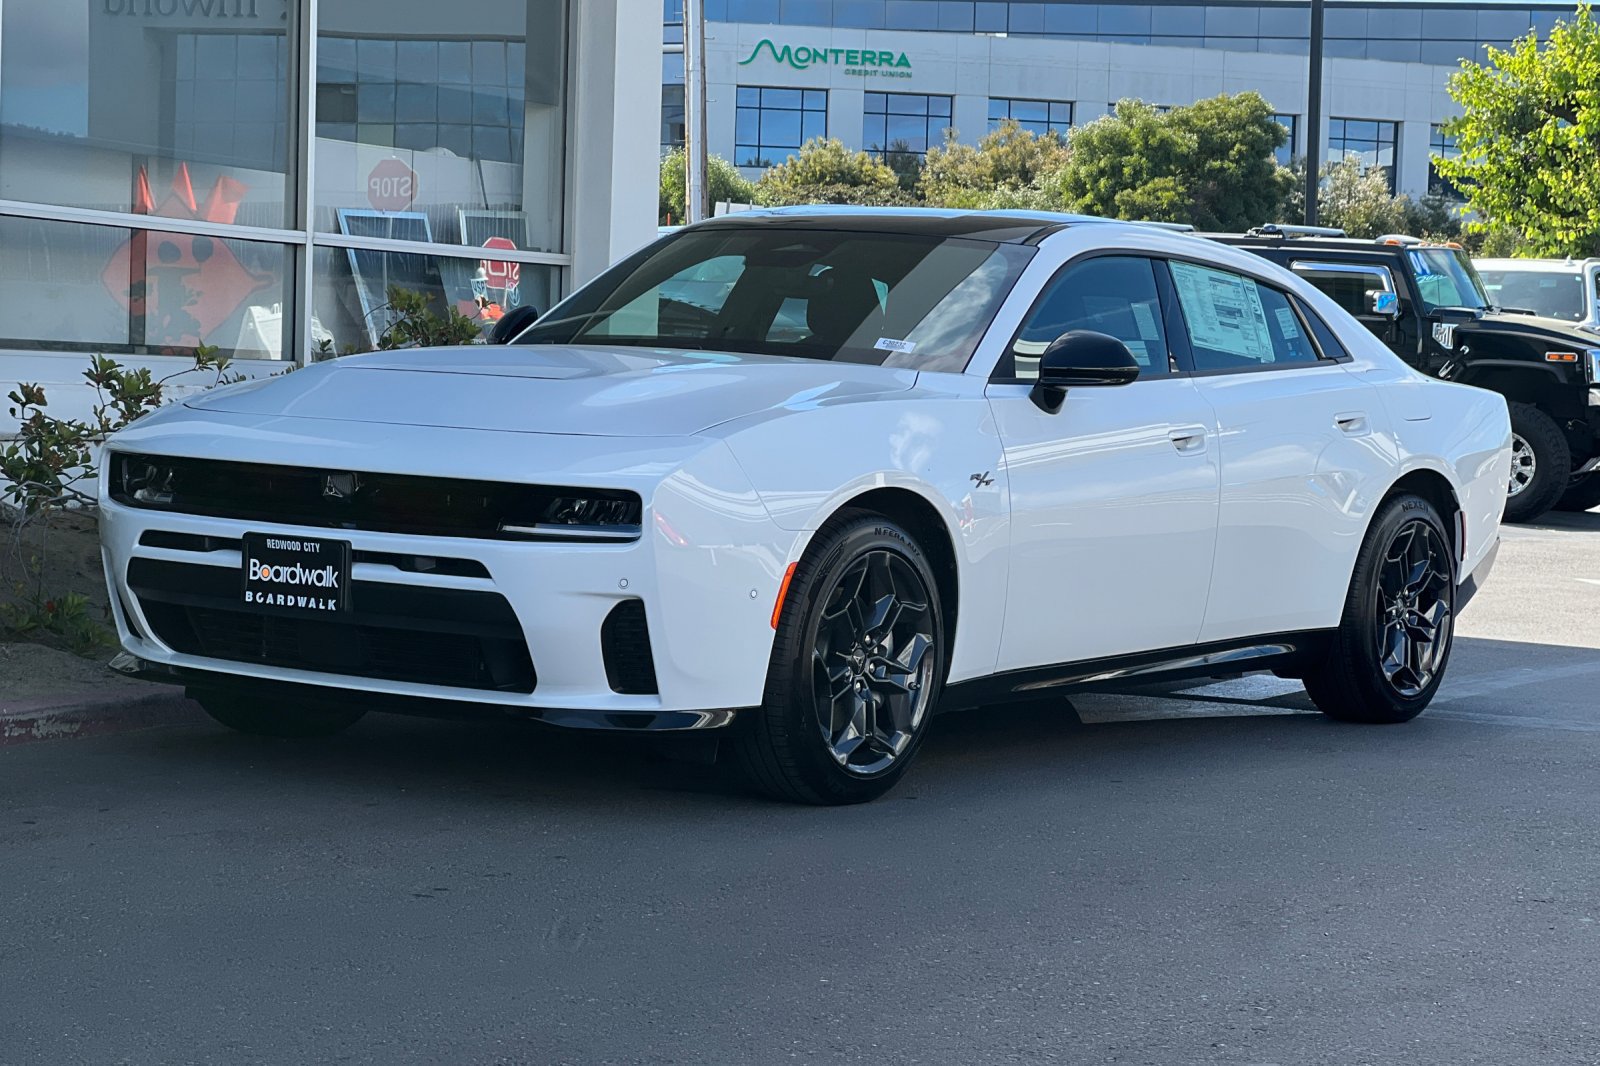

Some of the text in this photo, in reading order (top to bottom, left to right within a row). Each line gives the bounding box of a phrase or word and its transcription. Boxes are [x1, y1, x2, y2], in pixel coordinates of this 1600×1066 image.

[738, 39, 912, 70] MONTERRA
[844, 68, 912, 79] CREDIT UNION
[970, 471, 995, 488] R/T
[1401, 500, 1429, 512] NEXEN
[266, 539, 320, 553] REDWOOD CITY
[249, 558, 339, 588] Boardwalk
[245, 591, 337, 611] BOARDWALK
